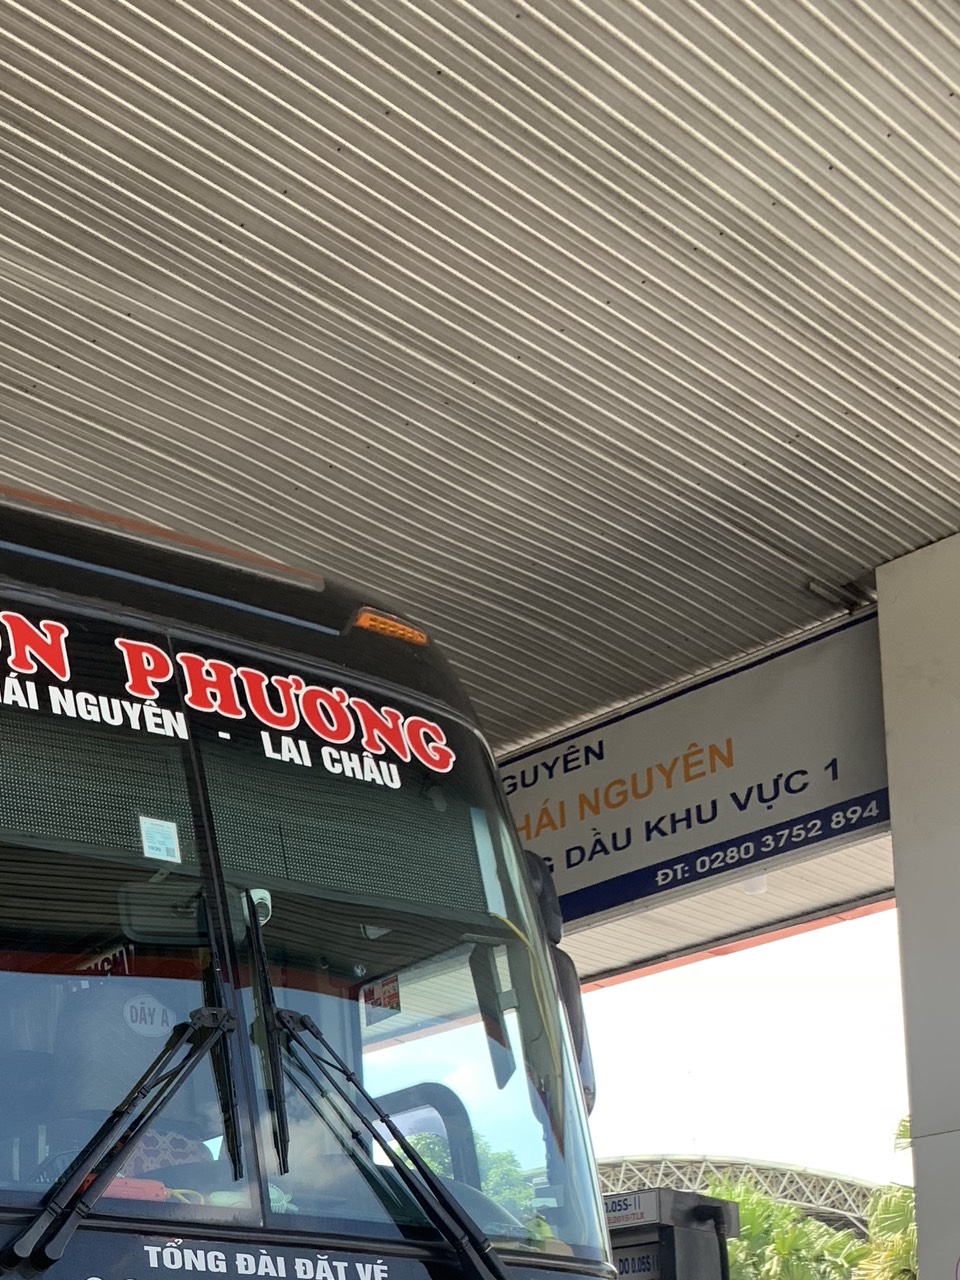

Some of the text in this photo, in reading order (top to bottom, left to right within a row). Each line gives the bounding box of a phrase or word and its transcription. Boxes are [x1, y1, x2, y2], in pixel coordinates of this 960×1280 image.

[48, 685, 189, 740] NGUYÊN
[260, 731, 312, 768] LAI
[321, 746, 401, 789] CHÂU
[114, 637, 456, 773] PHƯƠNG
[566, 827, 631, 869] DẦU
[645, 799, 718, 841] KHU
[730, 769, 809, 811] VỰC
[824, 758, 839, 781] 1
[579, 737, 734, 821] NGUYÊN
[655, 800, 879, 886] ĐT: 0280 3752 894
[160, 1008, 170, 1027] A
[144, 1238, 227, 1273] TỔNG
[236, 1249, 286, 1278] ĐÀI
